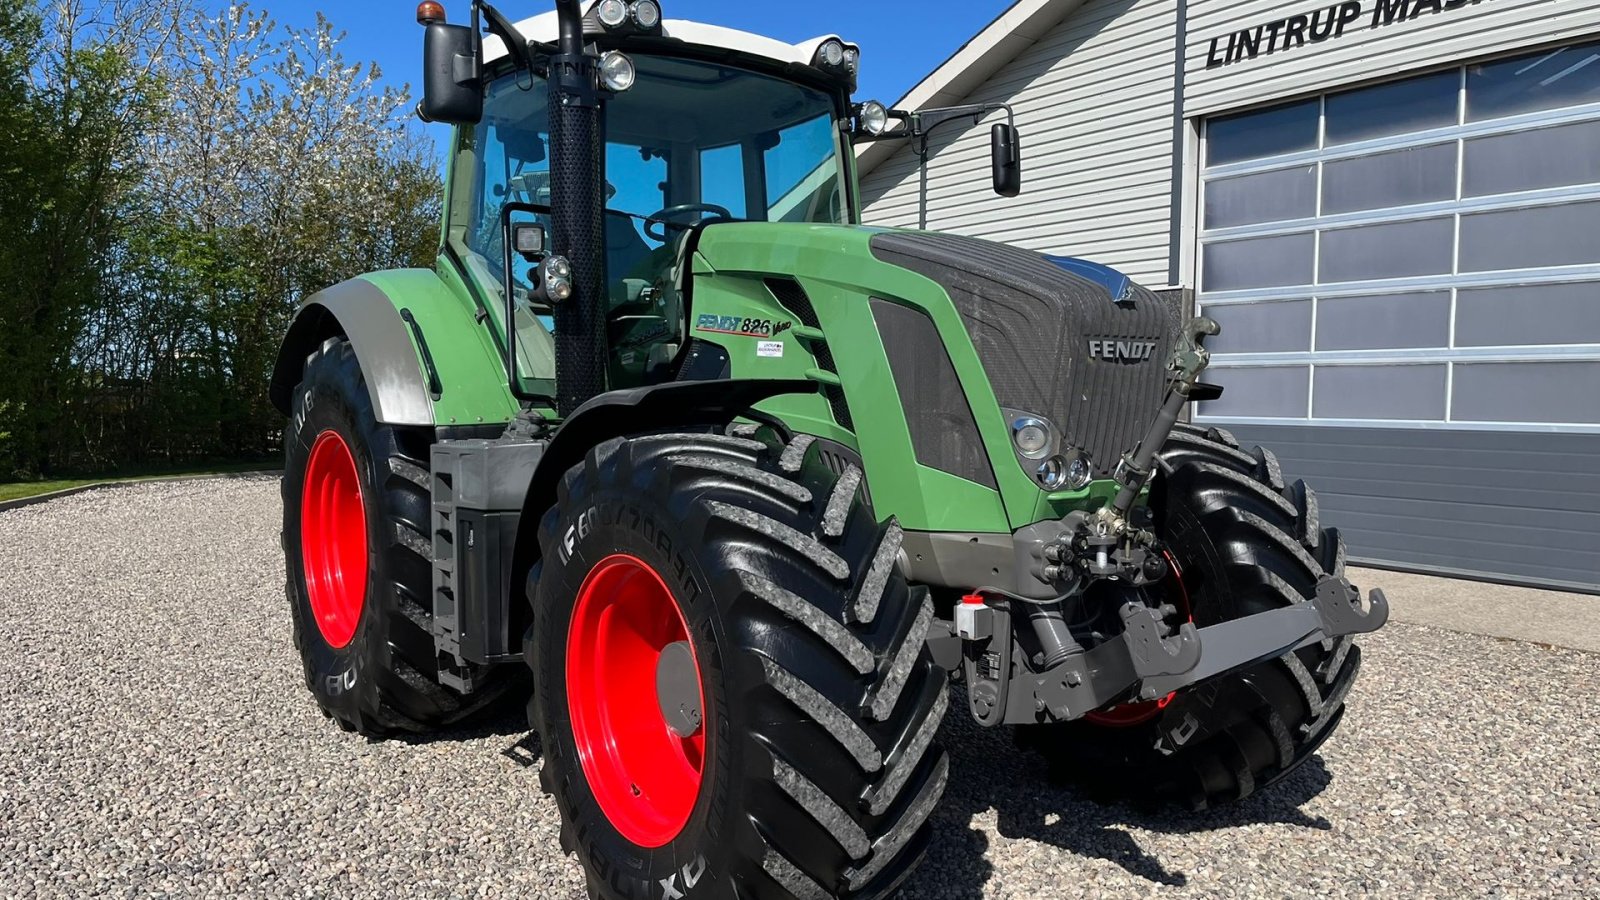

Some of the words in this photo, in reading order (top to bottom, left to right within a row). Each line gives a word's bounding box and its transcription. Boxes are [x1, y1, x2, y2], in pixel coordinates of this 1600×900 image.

[1205, 1, 1361, 70] LINTRUP
[695, 314, 742, 331] FENDT
[742, 318, 771, 334] 826
[1089, 340, 1156, 358] FENDT
